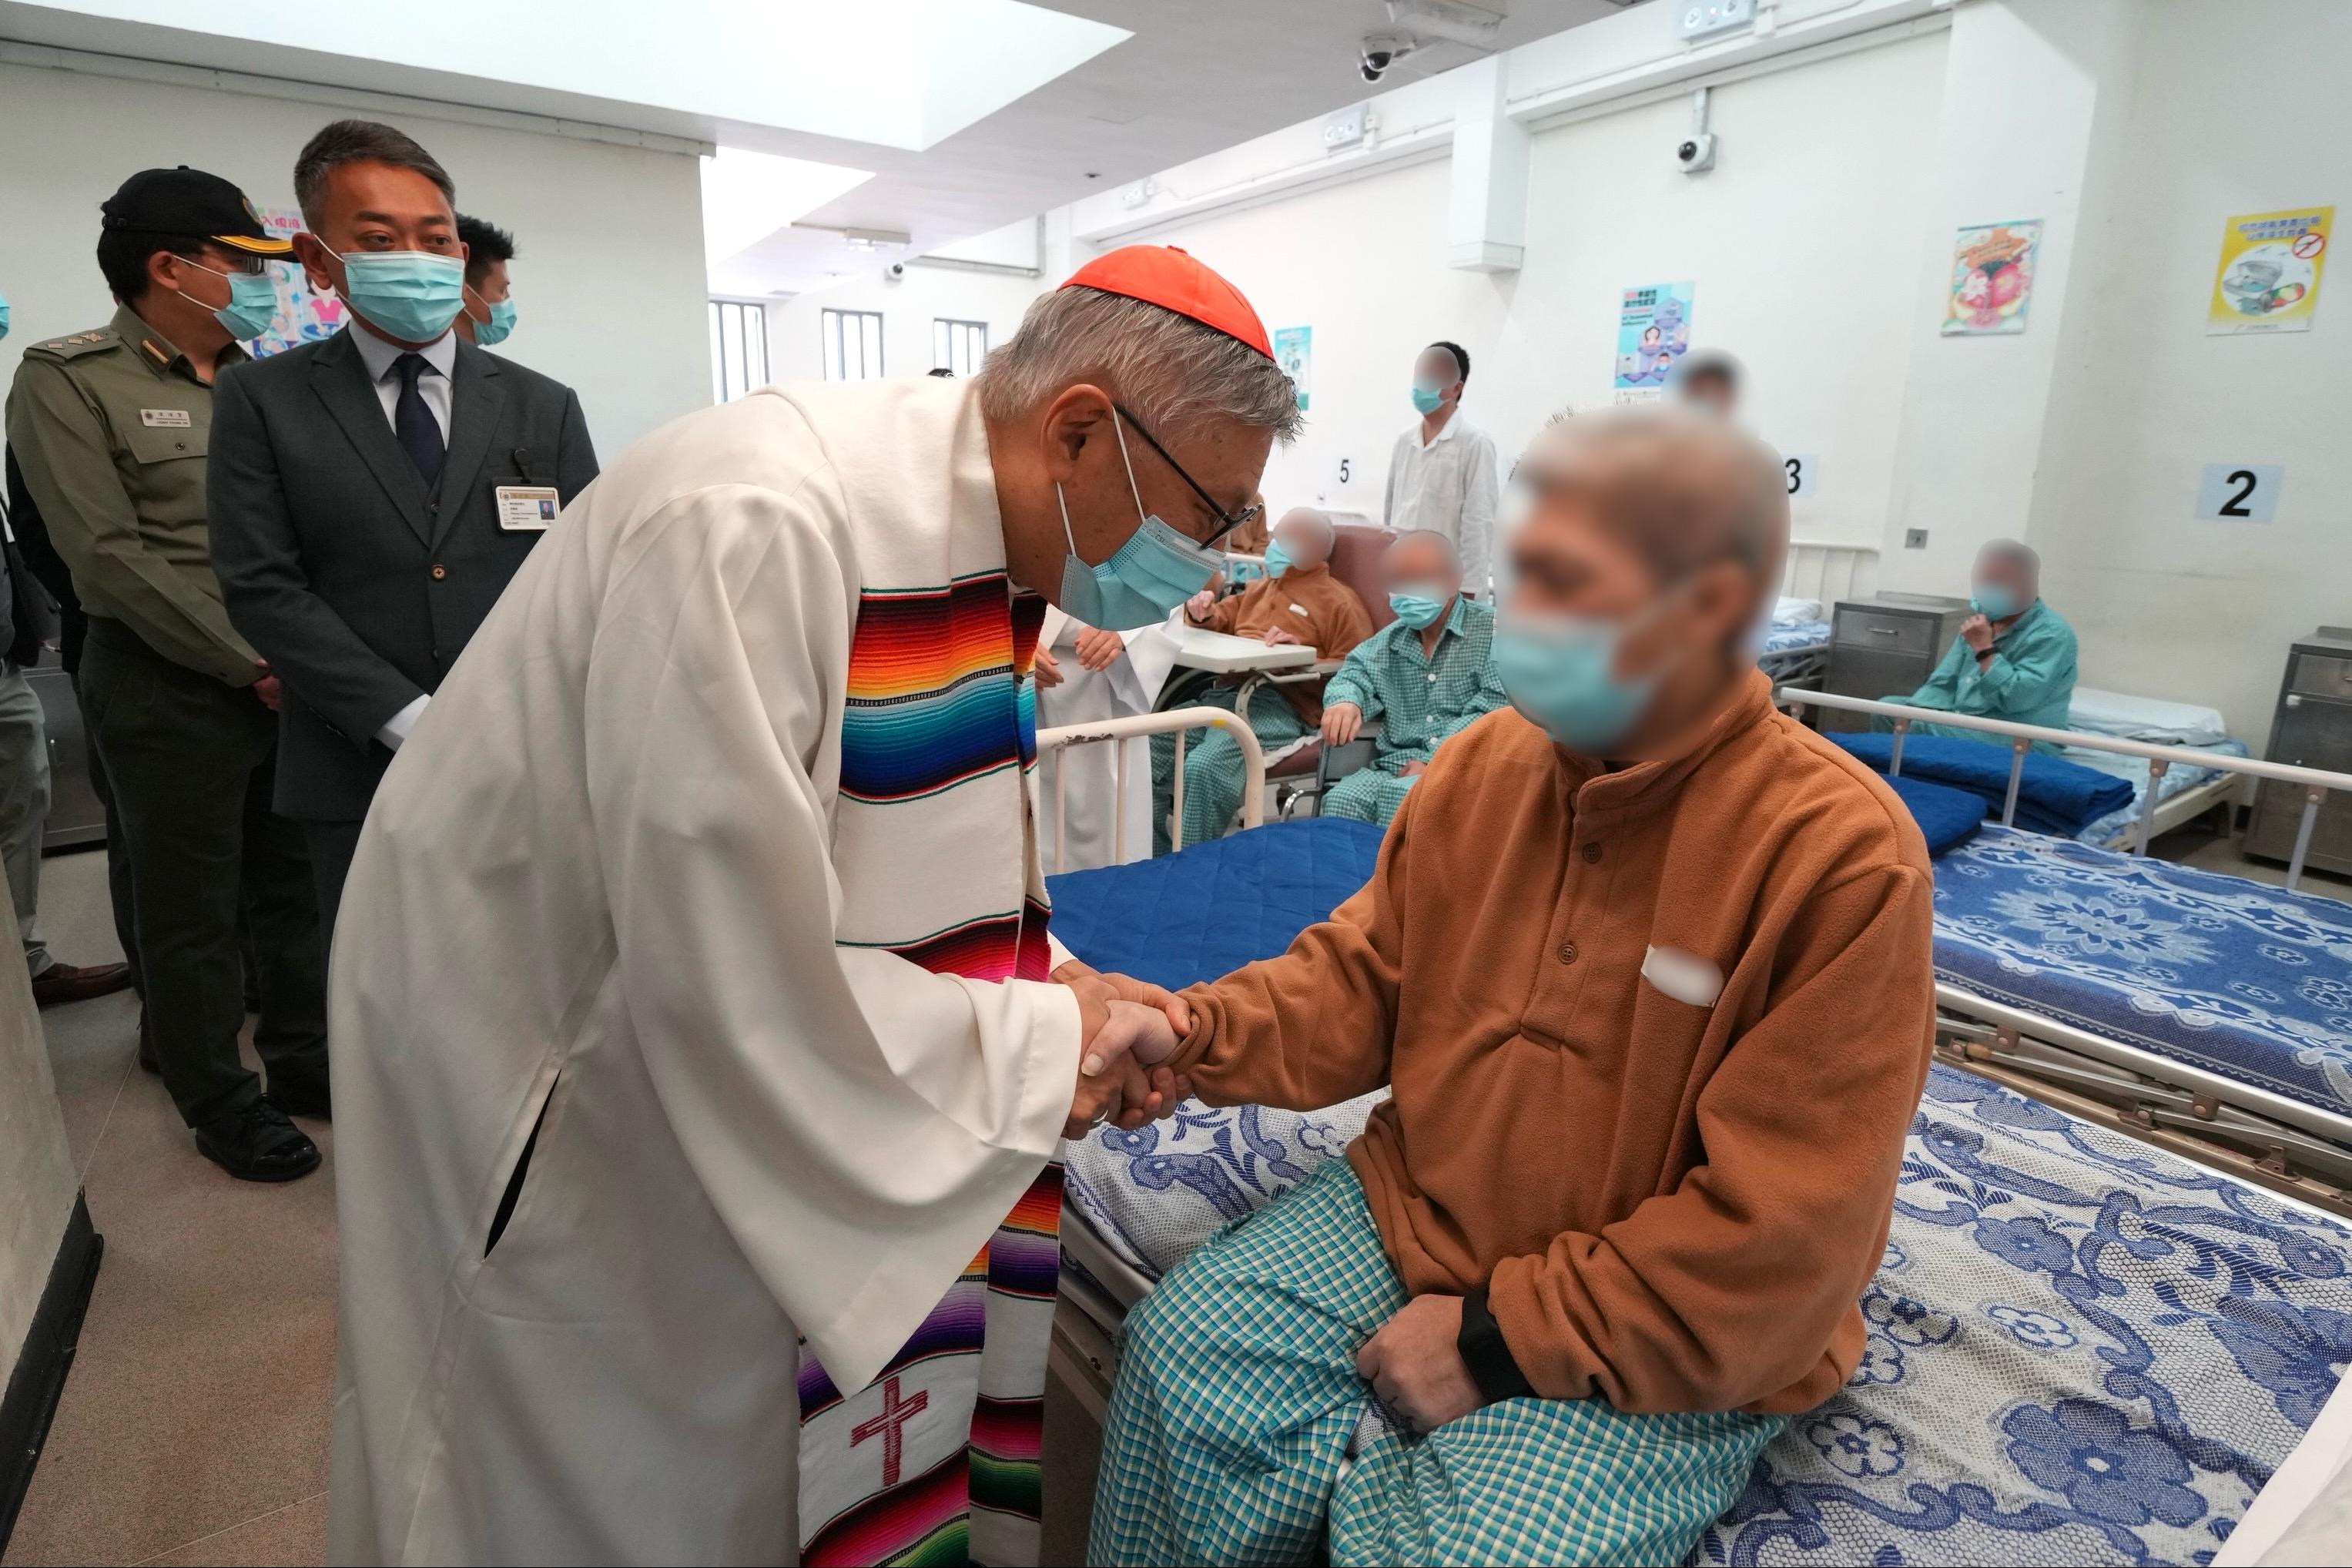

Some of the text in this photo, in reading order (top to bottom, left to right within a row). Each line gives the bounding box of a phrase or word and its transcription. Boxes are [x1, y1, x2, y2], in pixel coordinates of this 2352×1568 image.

[1340, 459, 1349, 483] 5
[1785, 458, 1801, 494] 3
[2218, 470, 2257, 517] 2
